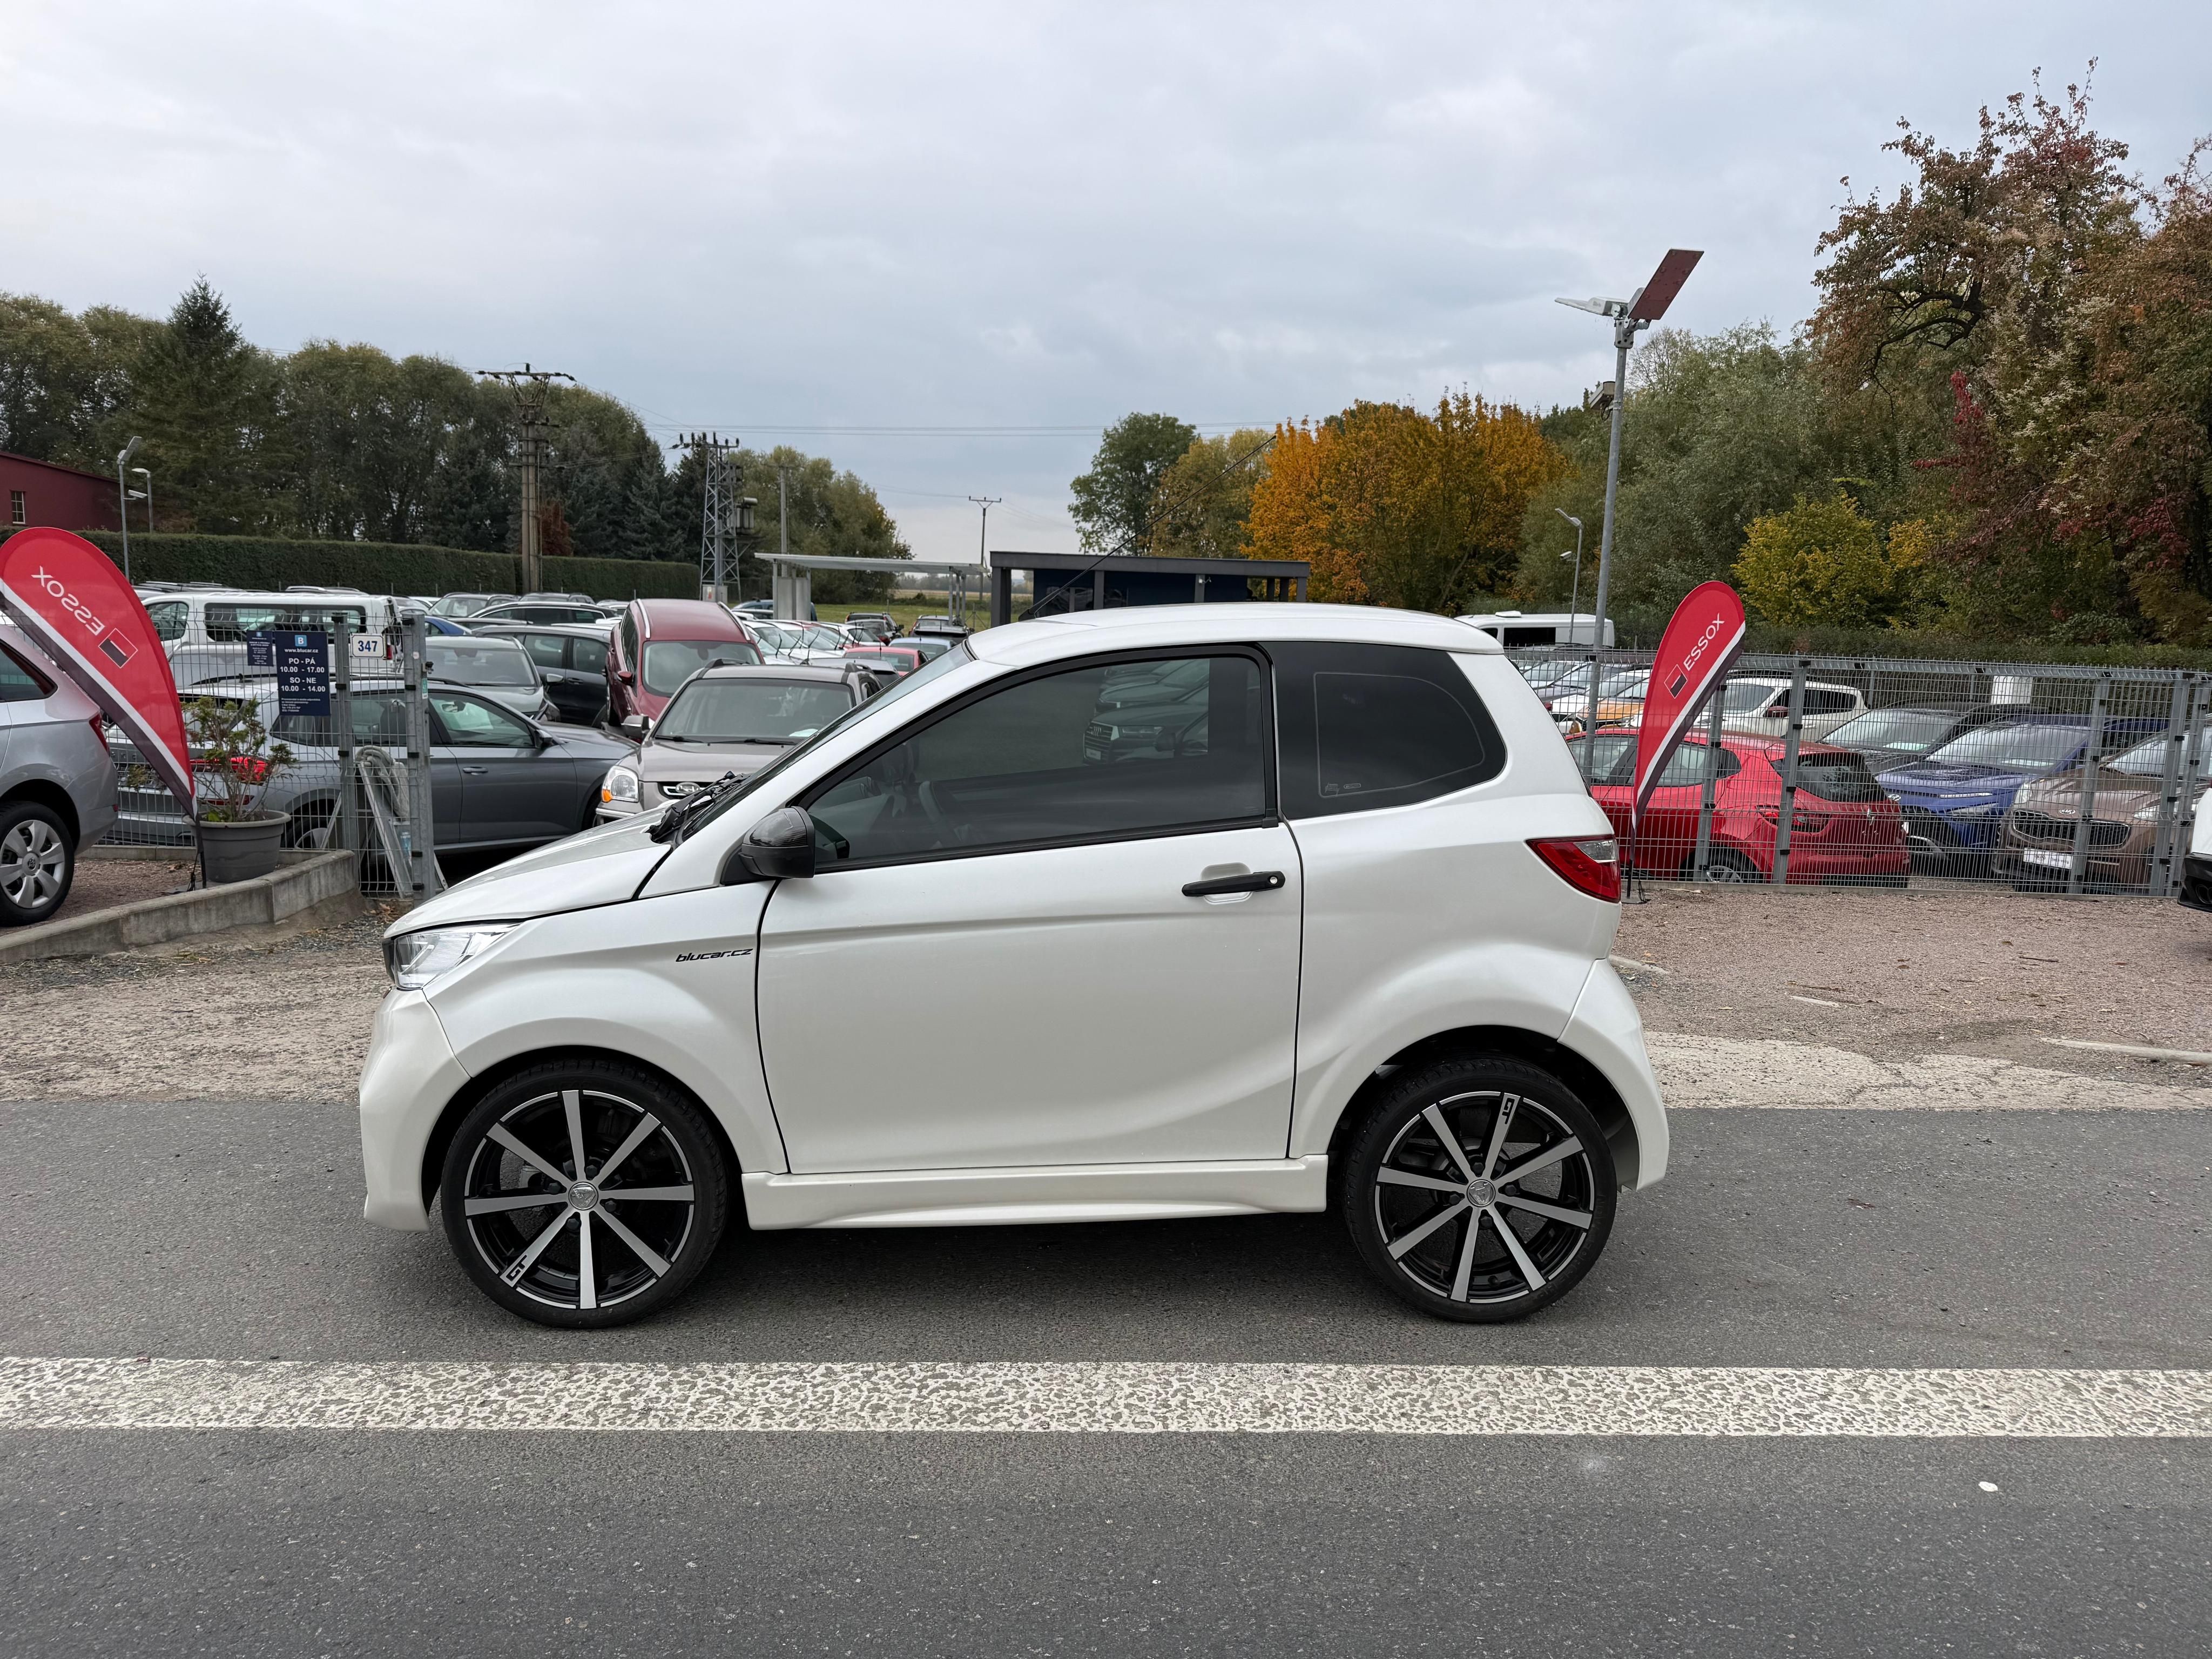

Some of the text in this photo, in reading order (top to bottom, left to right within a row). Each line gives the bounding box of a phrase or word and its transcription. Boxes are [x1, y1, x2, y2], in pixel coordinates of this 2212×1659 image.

[358, 640, 377, 652] 347
[1683, 612, 1724, 671] ESSOX
[676, 948, 753, 962] blucar.cz
[1502, 1098, 1515, 1124] GT
[505, 1254, 527, 1282] GT
